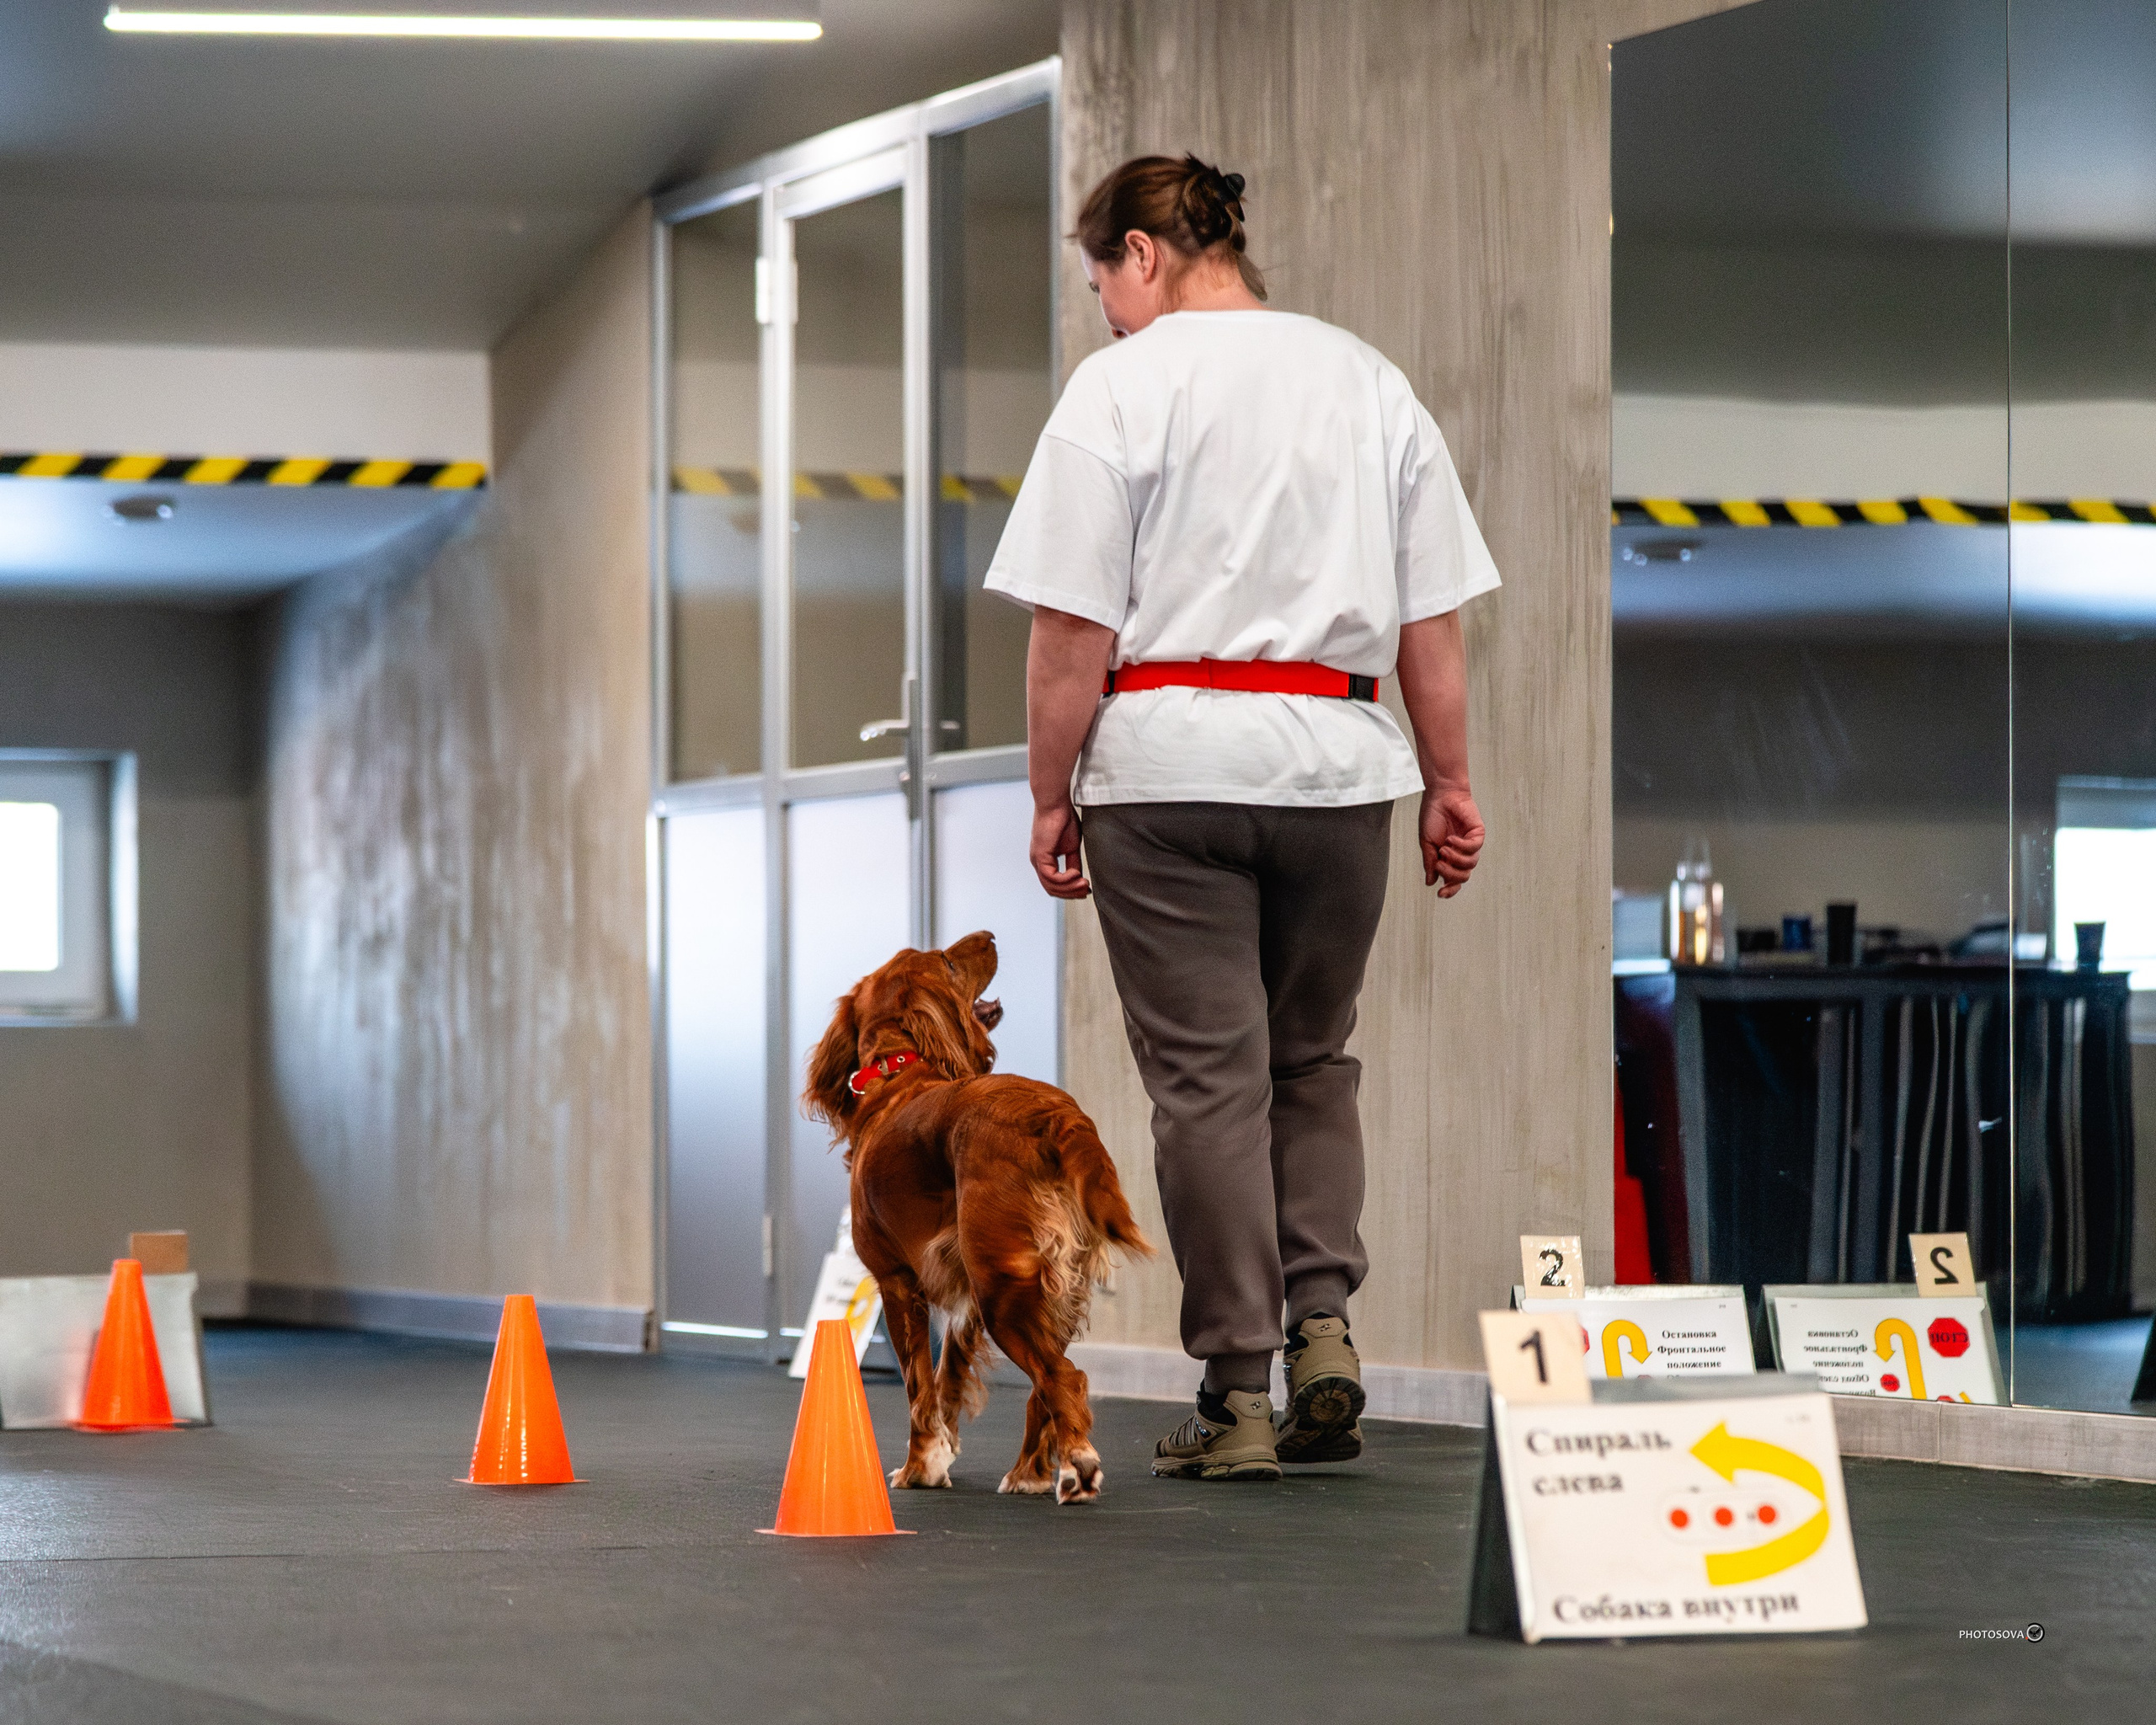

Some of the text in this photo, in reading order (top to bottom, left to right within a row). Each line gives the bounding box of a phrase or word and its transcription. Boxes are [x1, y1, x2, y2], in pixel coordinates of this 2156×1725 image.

[1539, 1248, 1566, 1286] 2
[1662, 1330, 1717, 1339] Остановка
[1519, 1328, 1548, 1386] 1
[1657, 1345, 1726, 1356] Фронтальное
[1667, 1360, 1722, 1370] положение
[1525, 1429, 1673, 1459] Спираль
[1533, 1474, 1624, 1496] слева
[1552, 1593, 1800, 1624] Собака внутри
